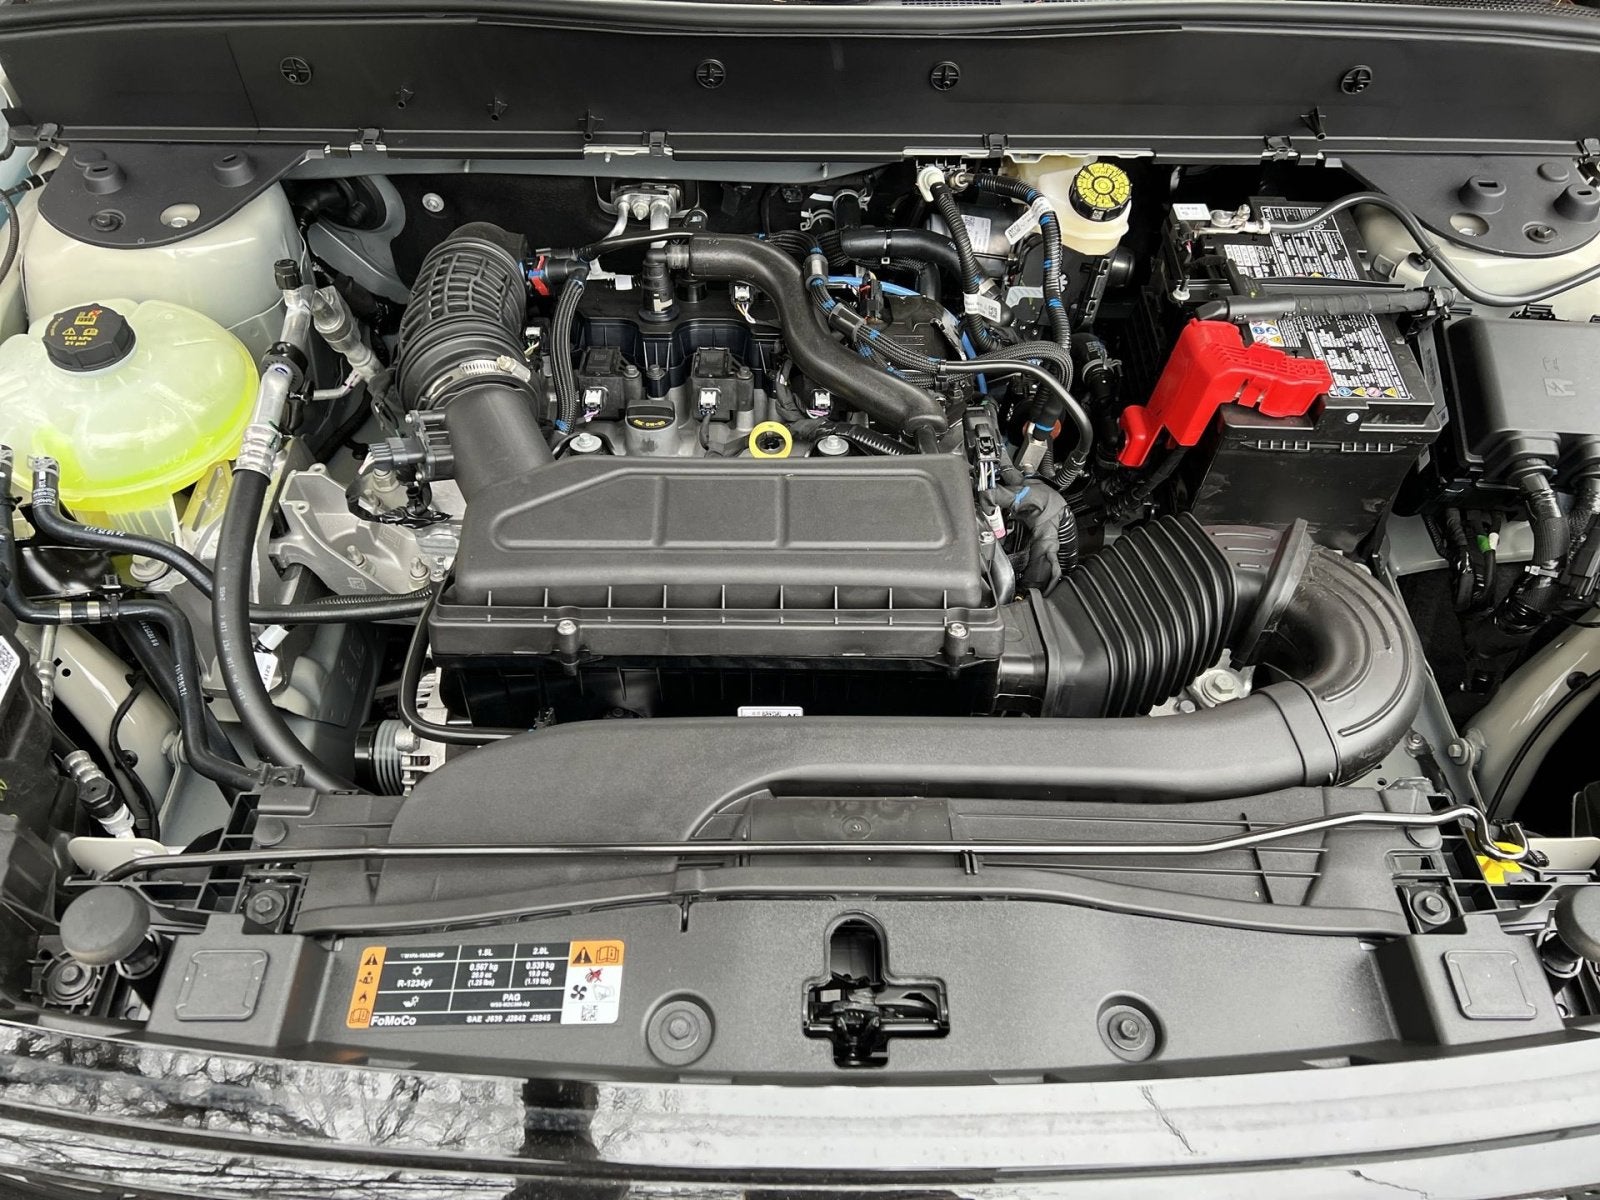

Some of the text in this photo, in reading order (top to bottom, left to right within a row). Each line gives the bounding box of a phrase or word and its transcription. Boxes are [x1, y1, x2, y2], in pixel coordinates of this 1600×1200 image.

[532, 947, 549, 955] 2.0L
[489, 963, 499, 973] kg
[545, 961, 555, 971] kg
[396, 978, 434, 990] R-1234yf
[502, 993, 521, 1002] PAG
[370, 1014, 417, 1027] FoMoCo
[466, 1015, 483, 1024] SAE
